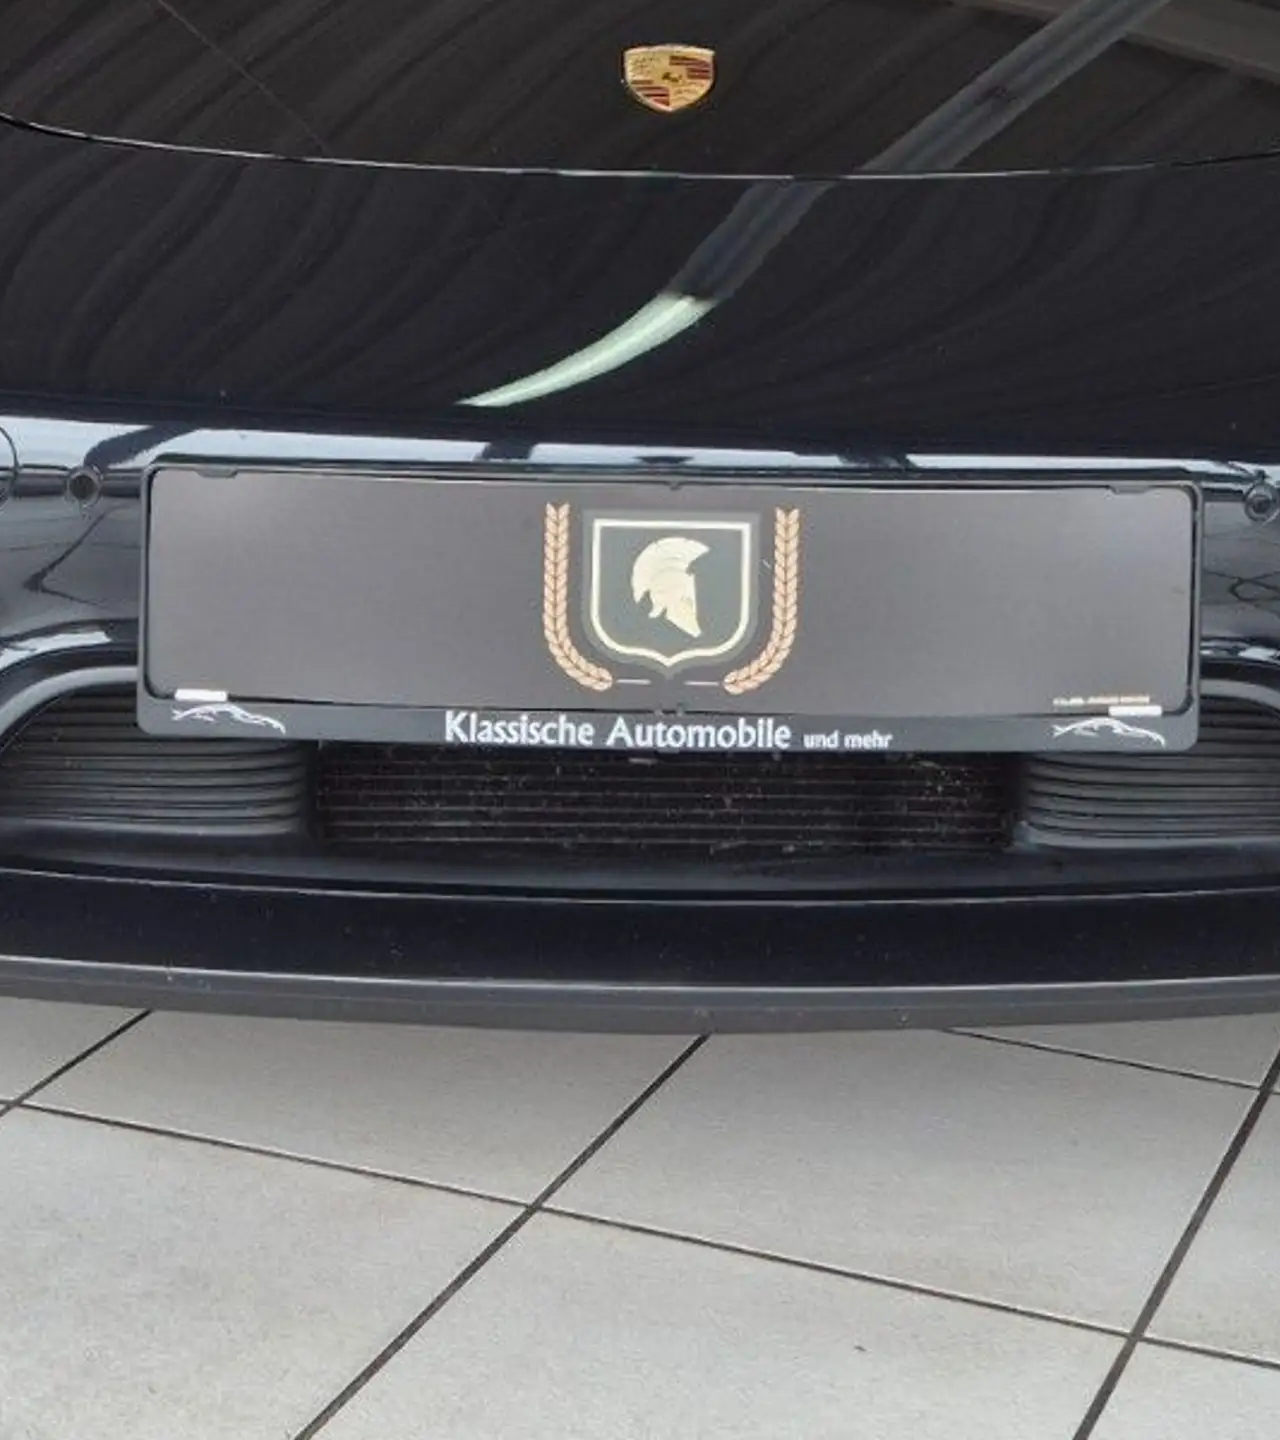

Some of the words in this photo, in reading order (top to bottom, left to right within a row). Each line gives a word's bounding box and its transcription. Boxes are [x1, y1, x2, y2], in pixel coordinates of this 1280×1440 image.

[444, 710, 596, 746] Klassische
[606, 716, 792, 750] Automobile
[803, 729, 840, 750] und
[844, 729, 894, 750] mehr
